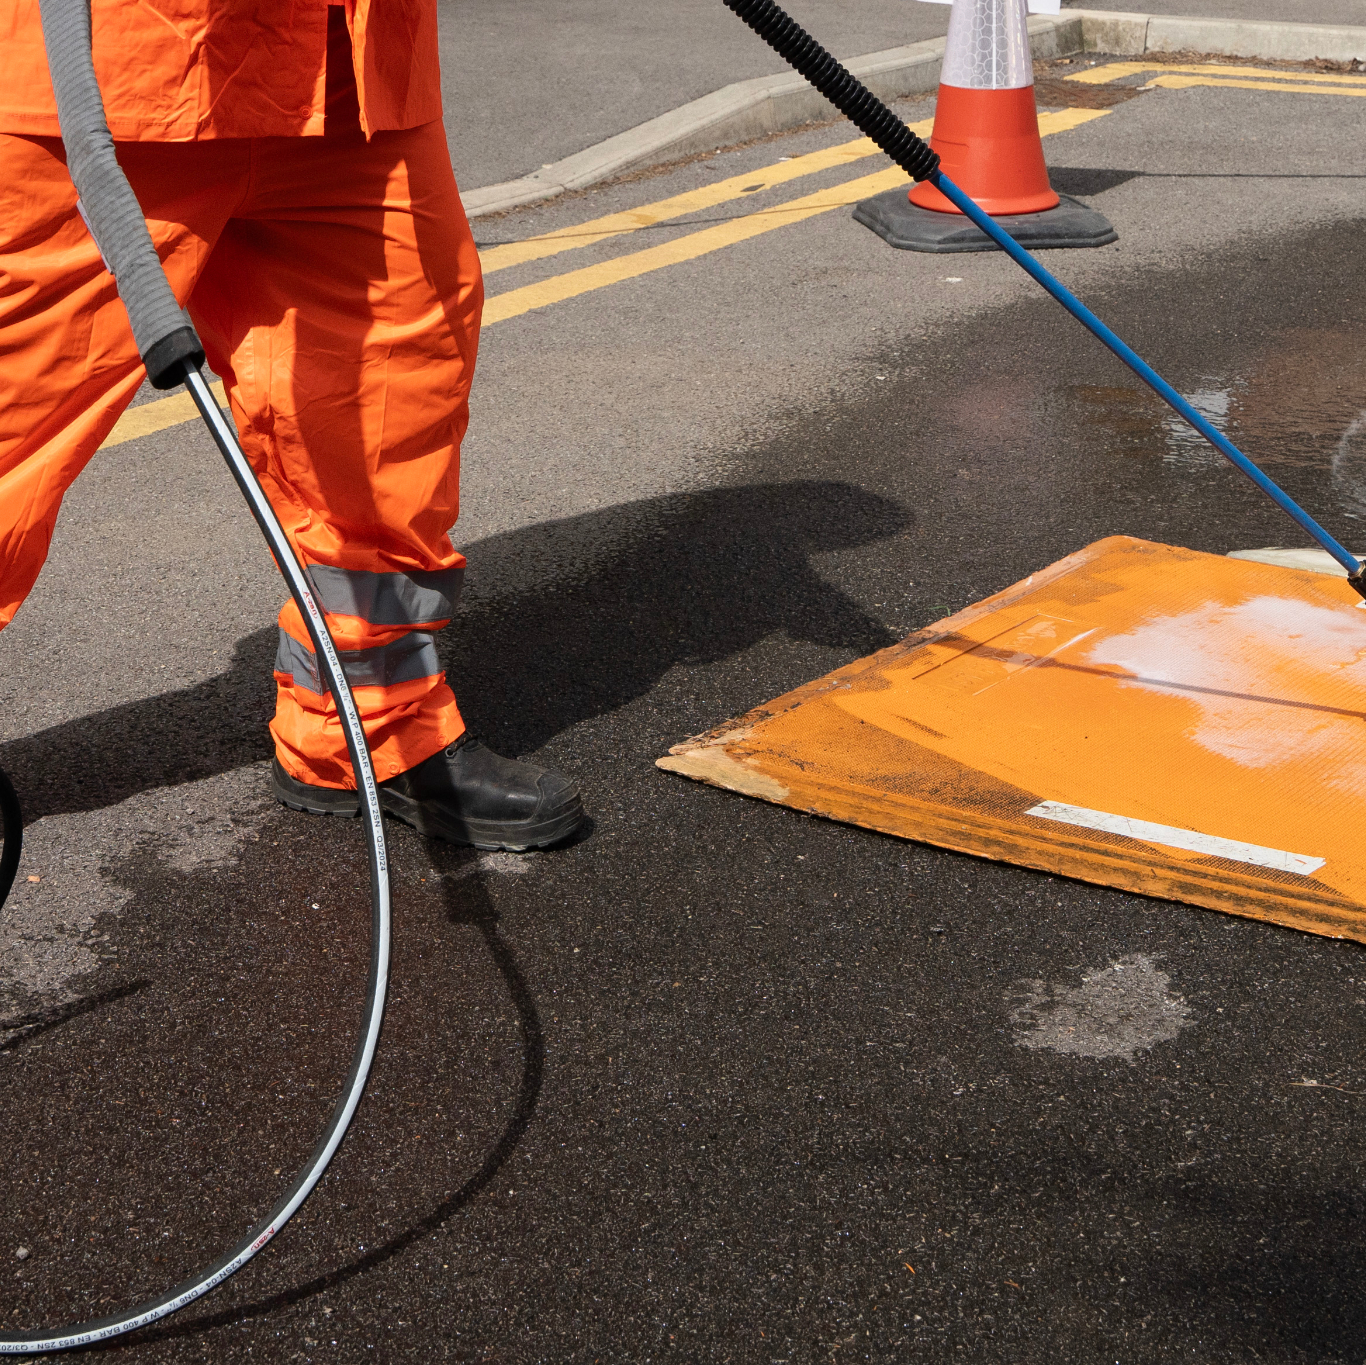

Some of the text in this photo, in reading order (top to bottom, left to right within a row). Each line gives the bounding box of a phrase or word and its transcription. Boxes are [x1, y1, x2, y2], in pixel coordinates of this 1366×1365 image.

[319, 630, 337, 666] A2SN-04
[337, 673, 347, 690] DN6
[355, 730, 363, 746] 400
[359, 748, 369, 768] BAR
[366, 776, 373, 789] EN
[369, 791, 377, 806] 853
[373, 809, 381, 828] 2SN
[377, 836, 385, 872] Q3/2024
[205, 1258, 242, 1288] A2SN-04
[179, 1290, 199, 1304] DN6
[99, 1326, 121, 1337] BAR
[123, 1320, 139, 1330] 400
[59, 1338, 75, 1346] 853
[78, 1334, 91, 1343] EN
